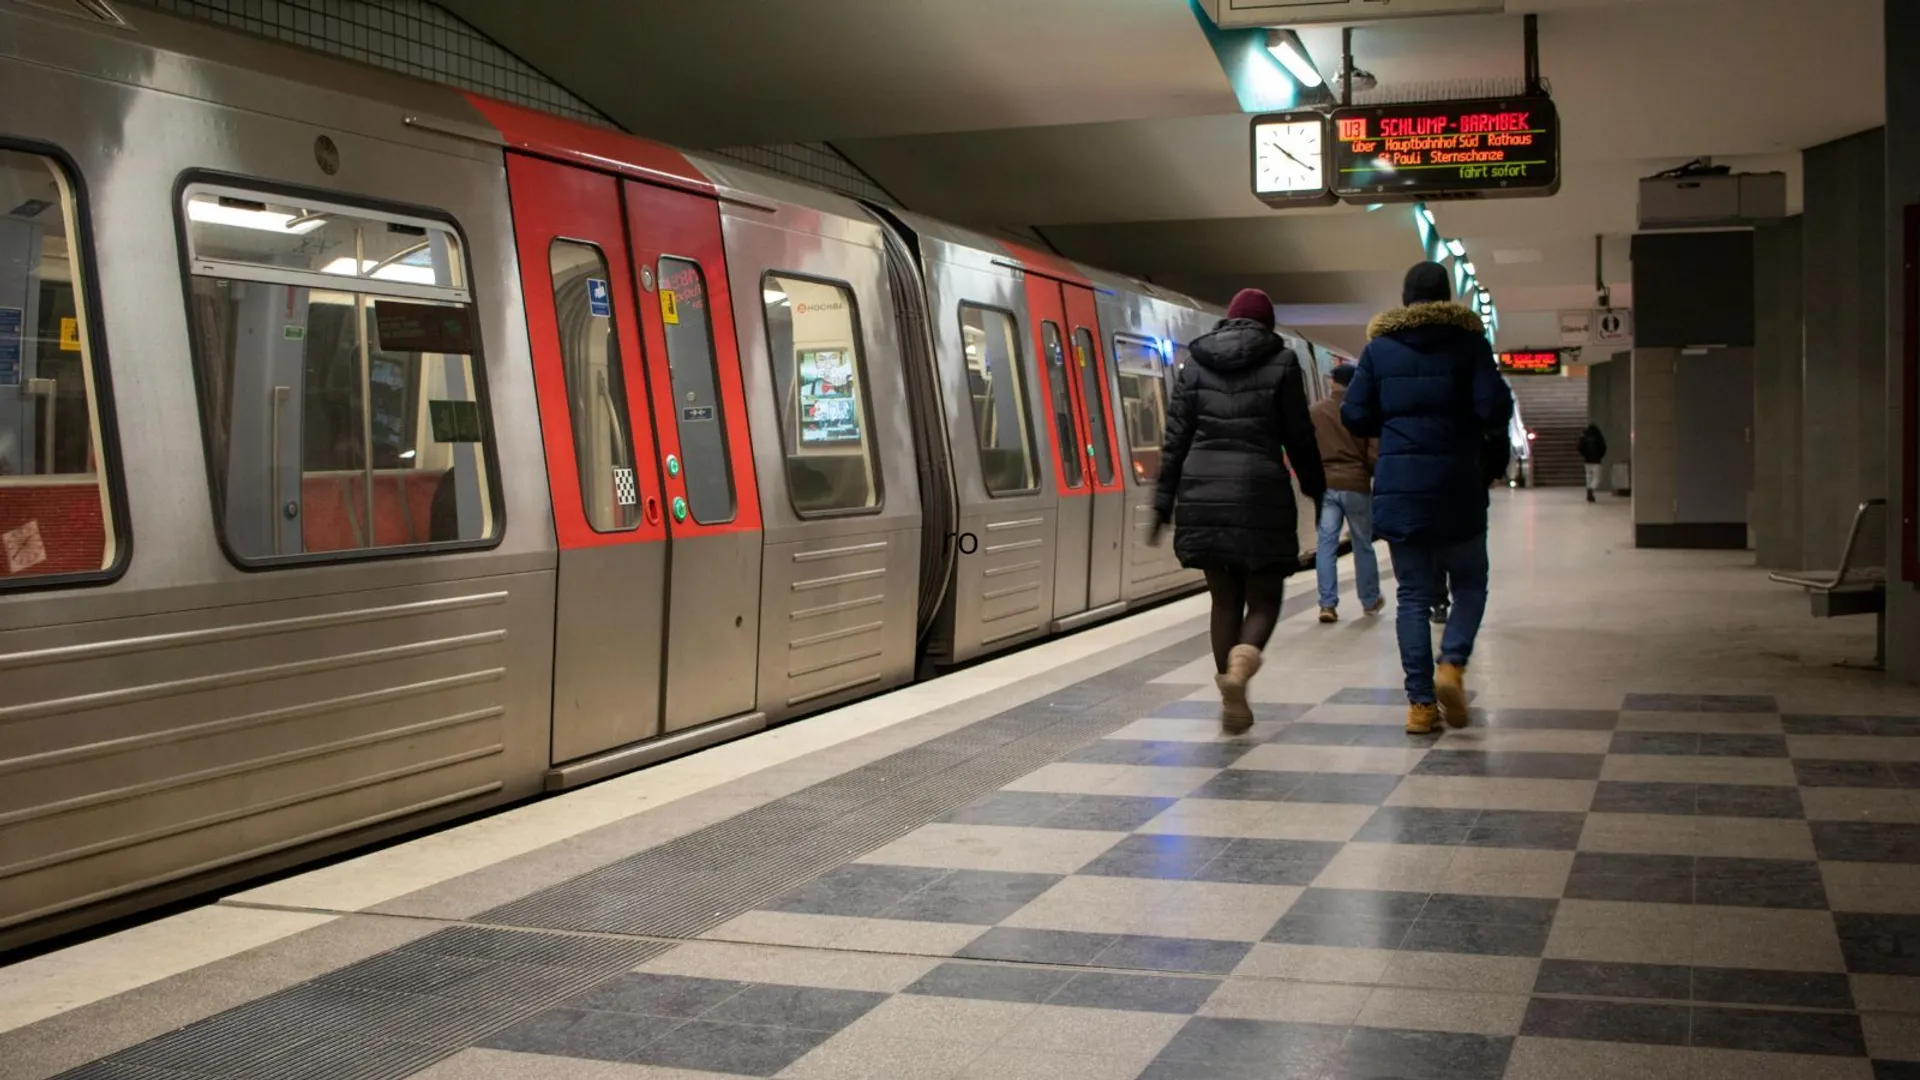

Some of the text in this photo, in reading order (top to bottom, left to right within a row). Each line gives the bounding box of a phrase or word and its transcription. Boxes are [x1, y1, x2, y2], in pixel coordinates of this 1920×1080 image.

[1344, 121, 1361, 138] U3
[1385, 135, 1457, 152] Hauptbahnhof
[1459, 135, 1479, 148] Süd
[1488, 133, 1532, 147] Rathaus
[1393, 151, 1421, 165] Pauli
[1430, 149, 1504, 164] Sternschanze
[1491, 164, 1527, 177] sofort
